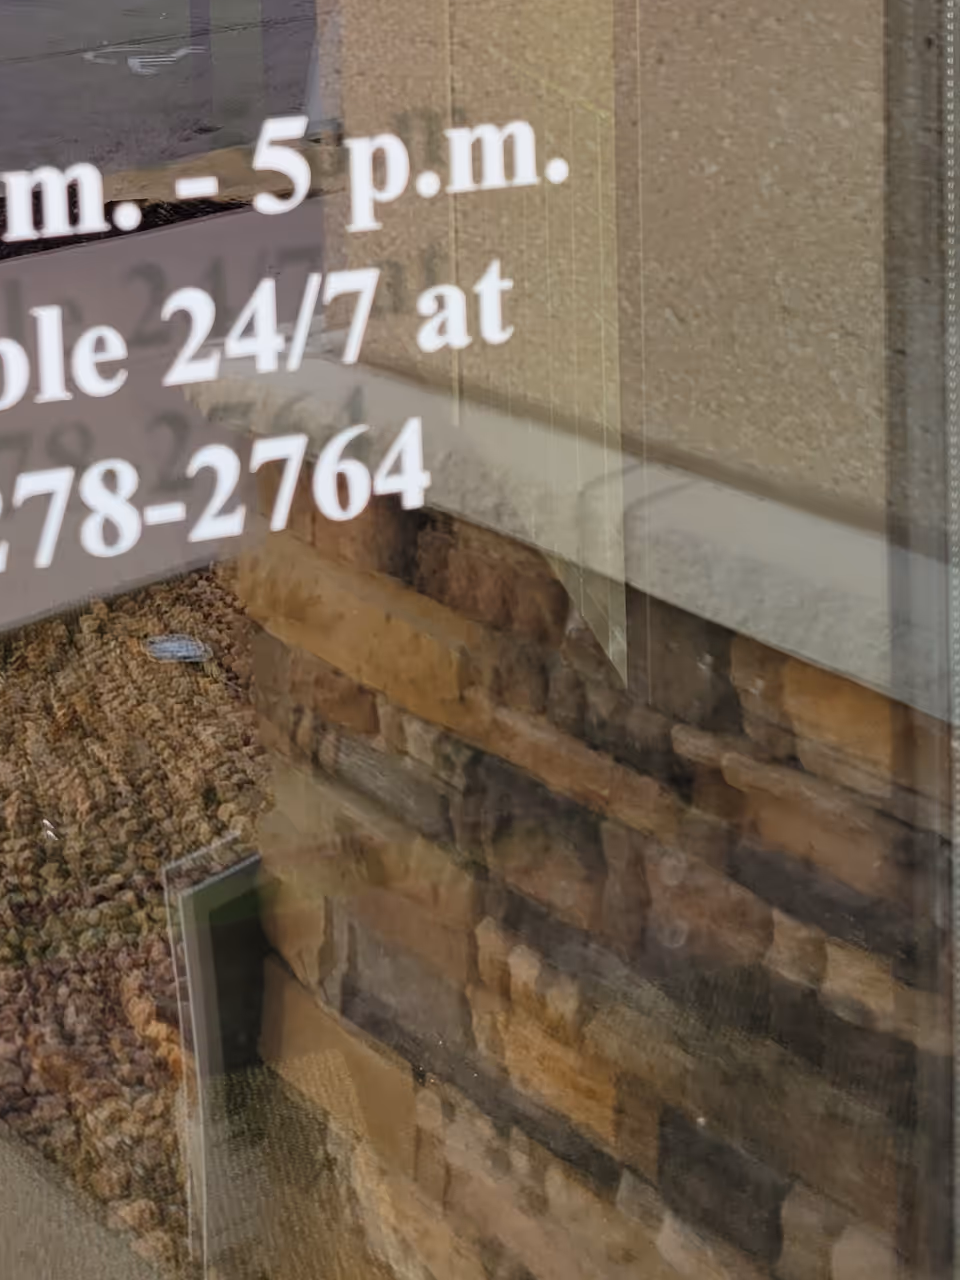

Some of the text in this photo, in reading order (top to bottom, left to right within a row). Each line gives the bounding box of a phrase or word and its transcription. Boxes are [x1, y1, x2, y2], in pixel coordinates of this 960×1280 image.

[175, 175, 219, 199] -
[252, 115, 312, 215] 5
[345, 120, 570, 233] p.m.
[160, 267, 381, 386] 24/7
[416, 259, 515, 353] at
